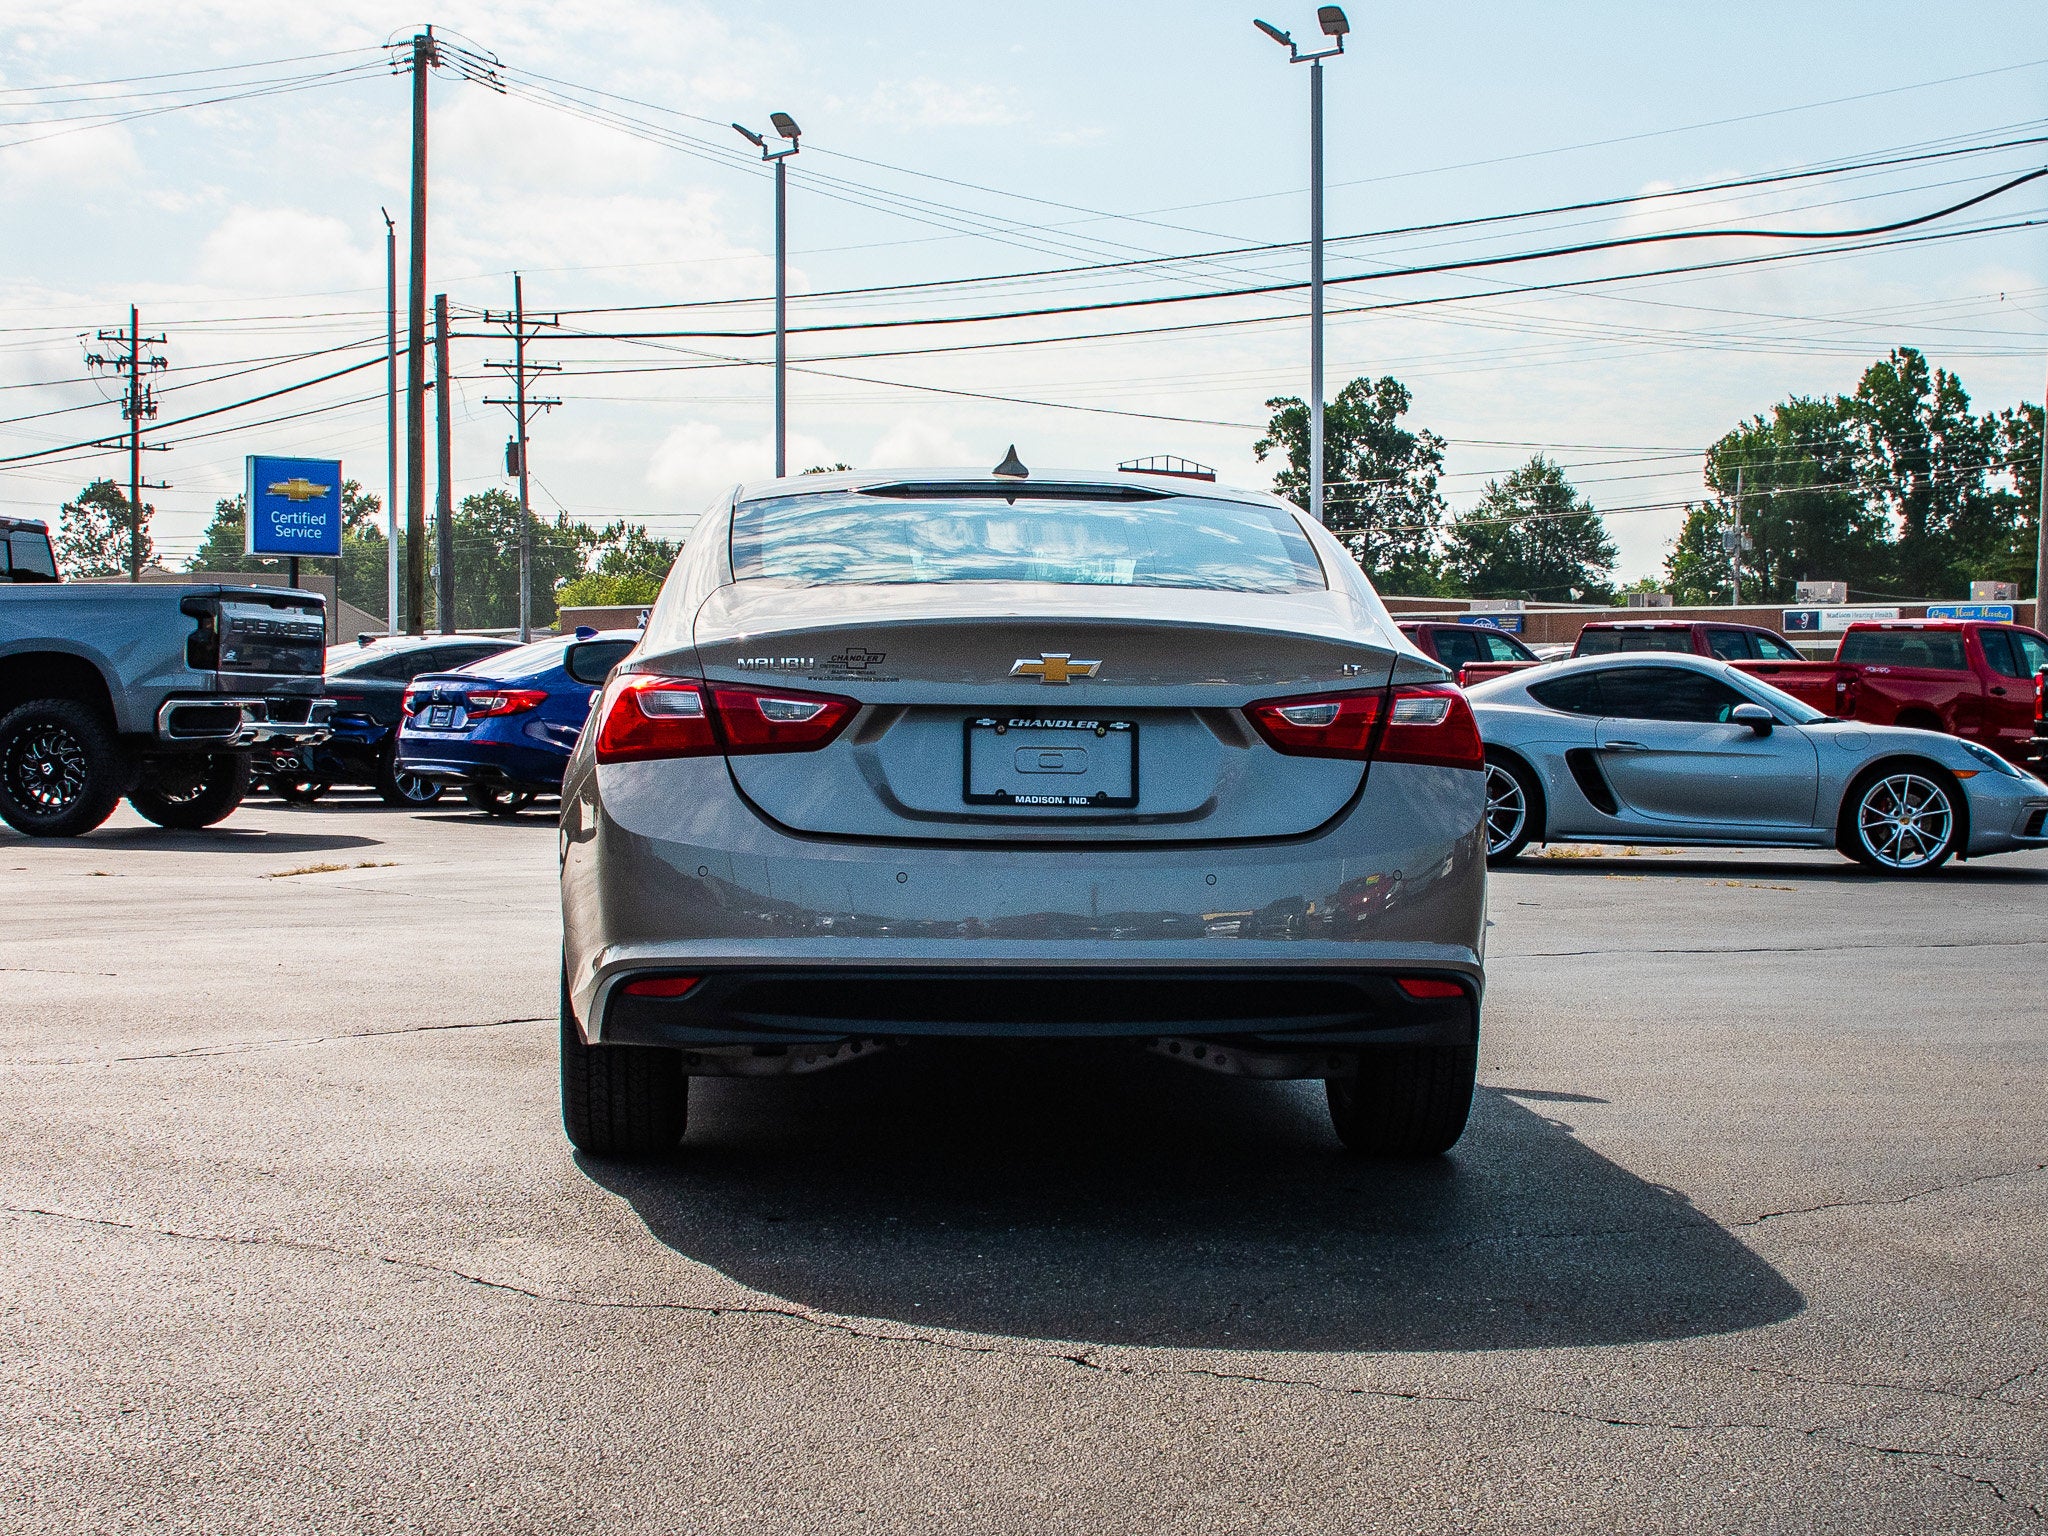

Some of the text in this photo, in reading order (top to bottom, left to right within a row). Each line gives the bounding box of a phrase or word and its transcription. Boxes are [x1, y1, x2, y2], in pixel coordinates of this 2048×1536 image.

[271, 511, 326, 525] Certified
[275, 525, 322, 538] Service
[737, 657, 814, 670] MALIBU
[831, 654, 879, 662] CHANDLER
[1343, 664, 1362, 676] LT
[1008, 718, 1098, 729] CHANDLER
[1069, 797, 1090, 805] IND.
